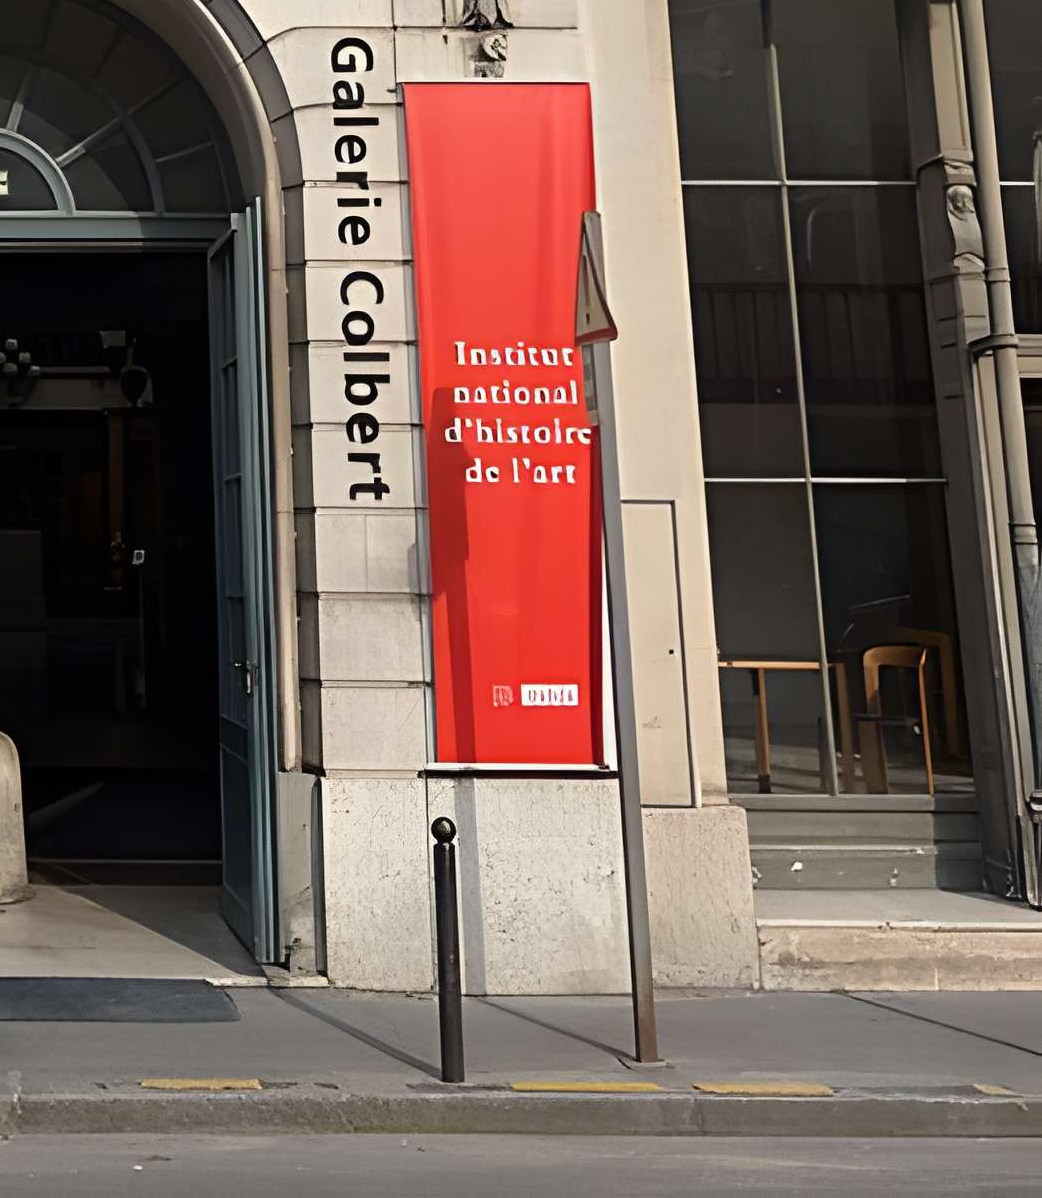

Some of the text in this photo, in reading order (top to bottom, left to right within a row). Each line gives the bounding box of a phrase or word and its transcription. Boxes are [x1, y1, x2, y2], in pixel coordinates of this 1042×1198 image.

[331, 37, 390, 500] Galerie Colbert
[454, 341, 574, 366] Institut
[454, 379, 578, 404] national
[444, 417, 592, 445] d'histoire
[465, 457, 576, 483] de l'art
